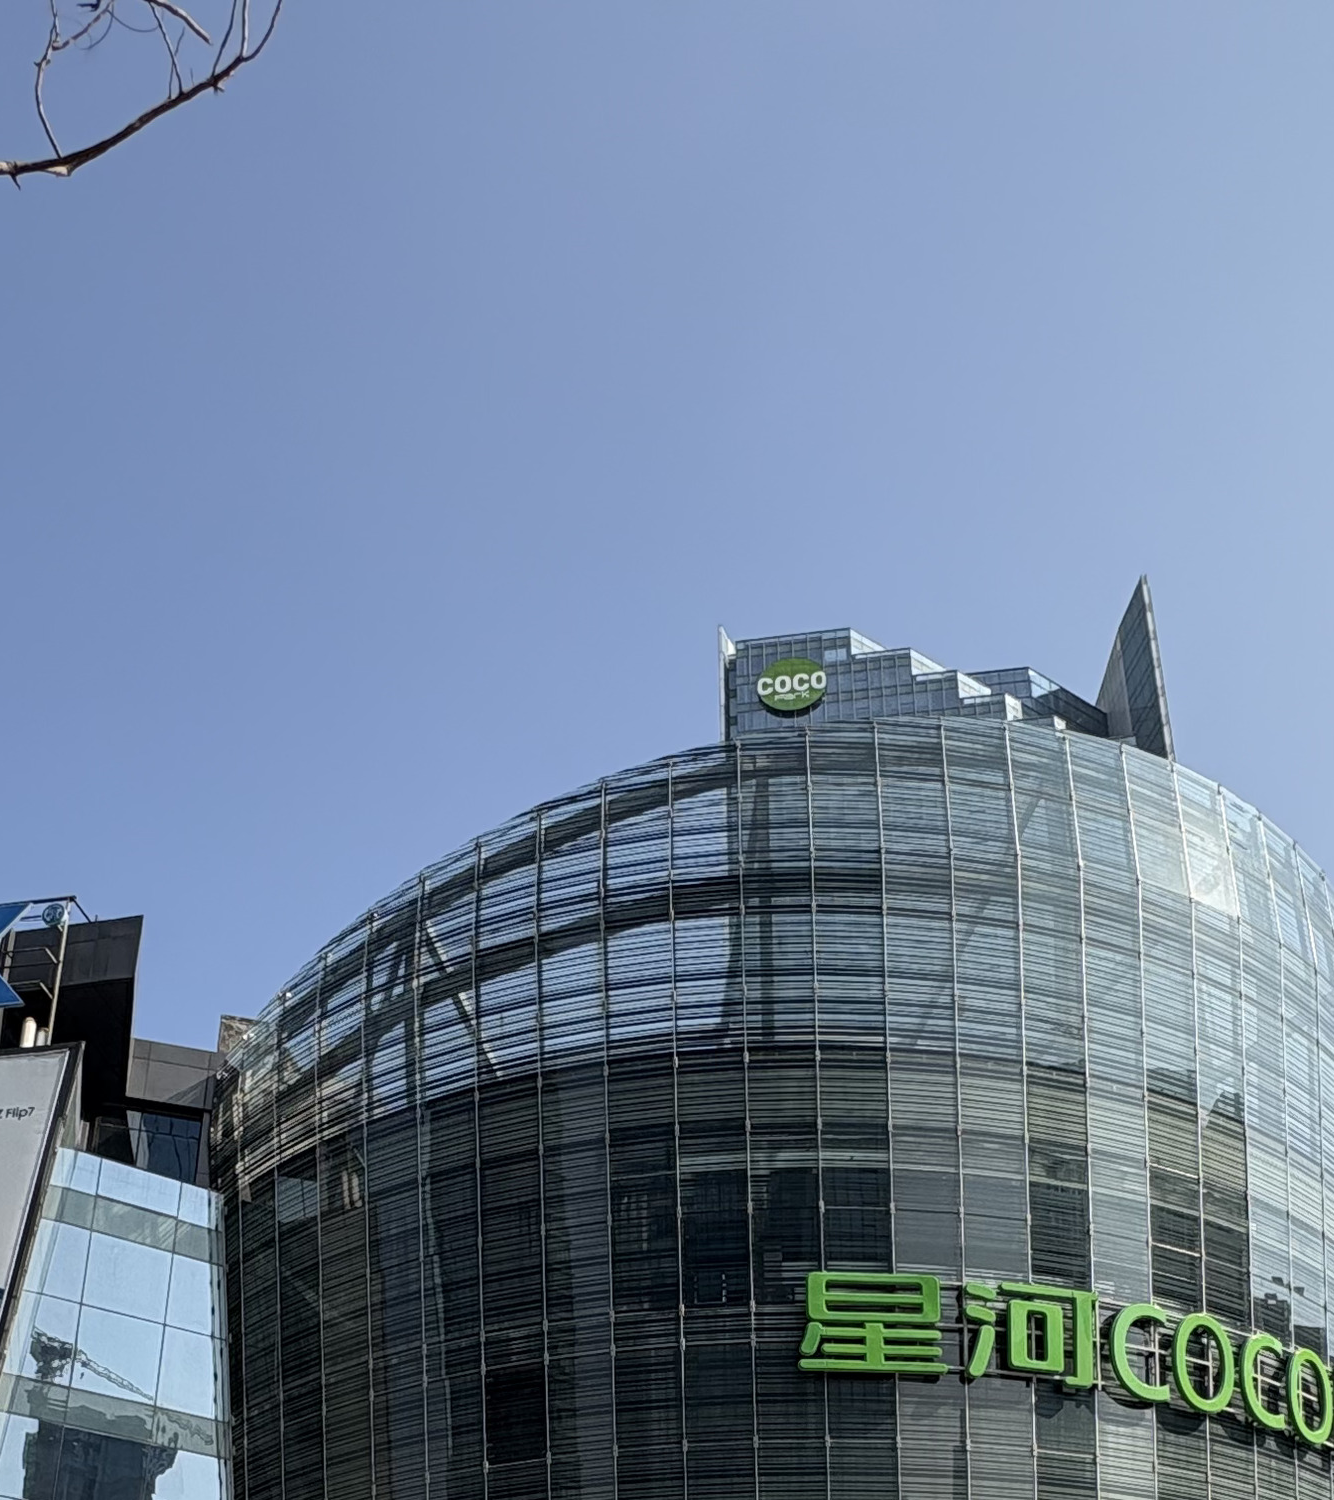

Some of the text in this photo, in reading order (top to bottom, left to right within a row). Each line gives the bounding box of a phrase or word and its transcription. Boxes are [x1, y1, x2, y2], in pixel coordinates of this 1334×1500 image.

[757, 671, 827, 696] COCO
[5, 1107, 36, 1121] Flip7
[797, 1271, 1100, 1390] 星河
